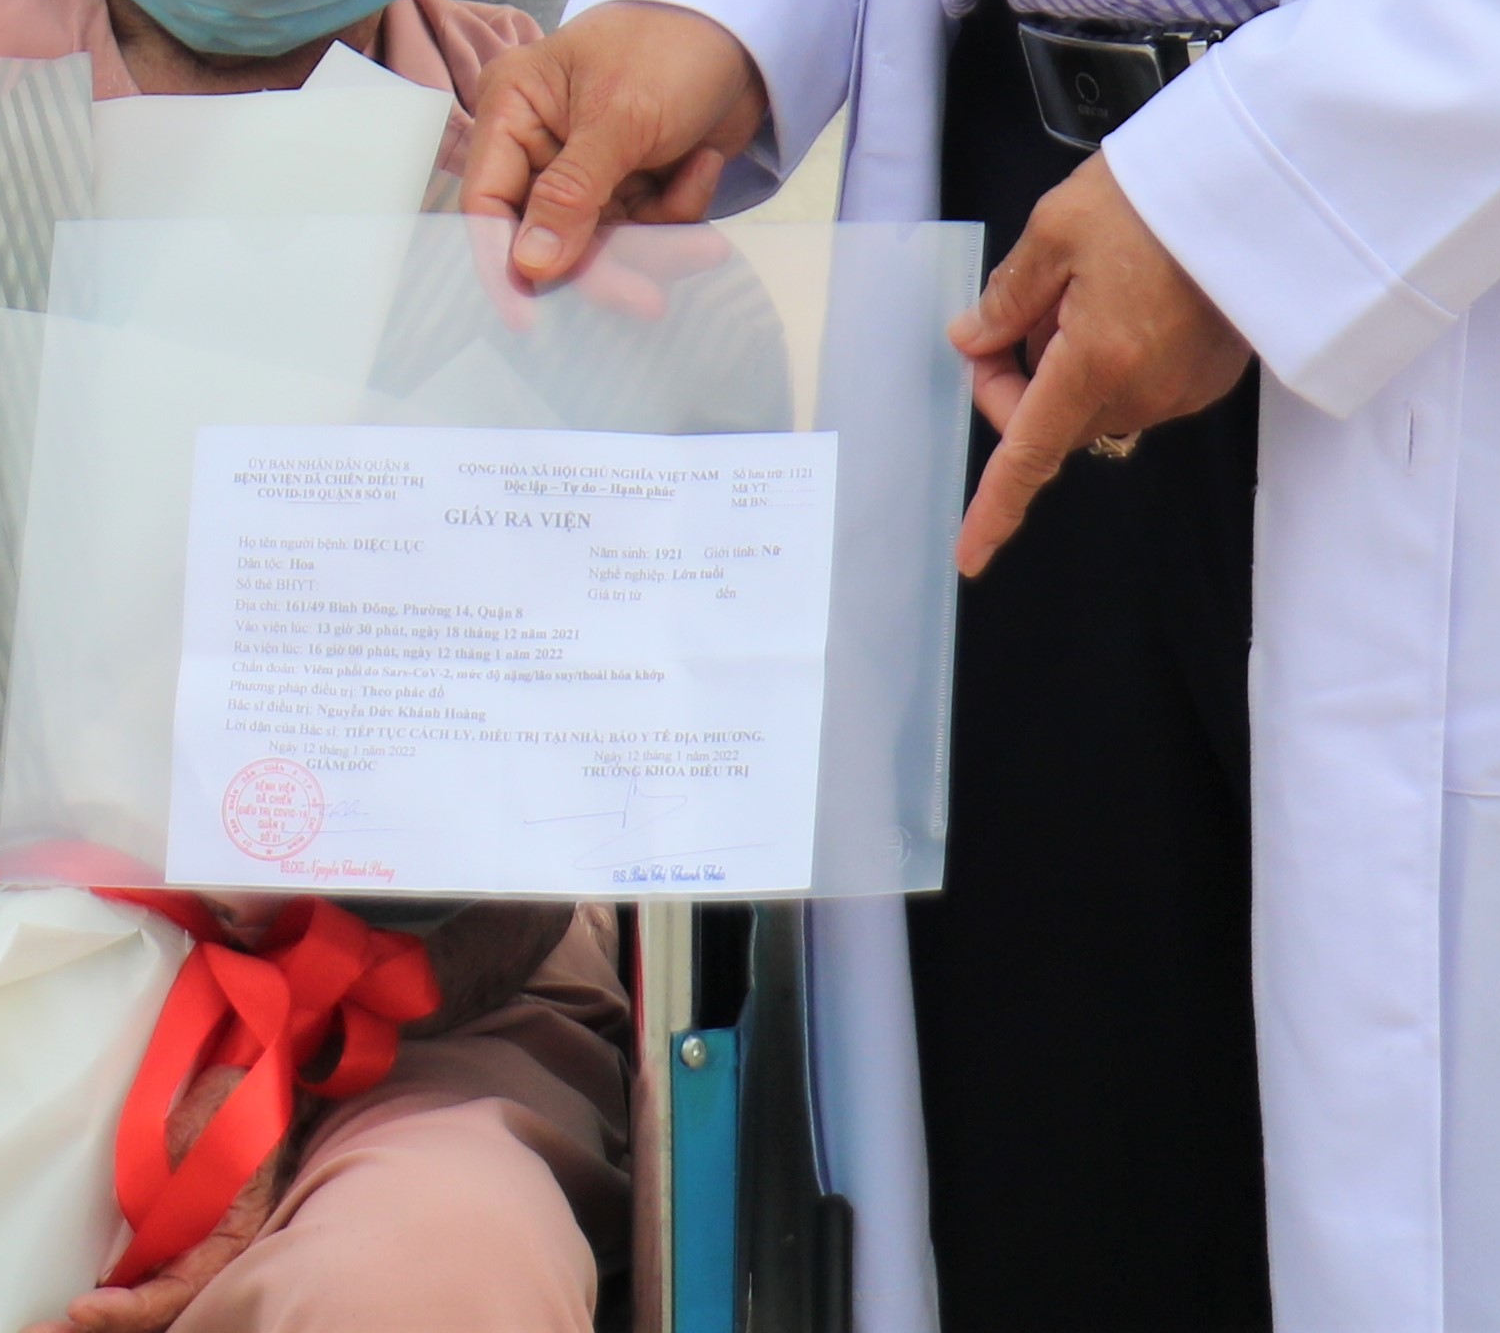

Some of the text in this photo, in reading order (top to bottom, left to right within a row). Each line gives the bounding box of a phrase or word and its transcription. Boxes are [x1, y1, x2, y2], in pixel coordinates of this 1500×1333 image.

[690, 469, 720, 480] NAM
[504, 512, 533, 527] RA
[538, 510, 592, 531] VIỆN
[655, 548, 682, 559] 1921
[289, 559, 315, 569] Hoa
[316, 622, 331, 633] 13
[356, 624, 372, 635] 30
[445, 626, 460, 637] 18
[503, 628, 518, 639] 12
[551, 630, 580, 641] 2021
[308, 644, 323, 655] 16
[437, 648, 451, 659] 12
[534, 651, 564, 662] 2022
[360, 685, 393, 696] Theo
[644, 765, 686, 776] KHOA
